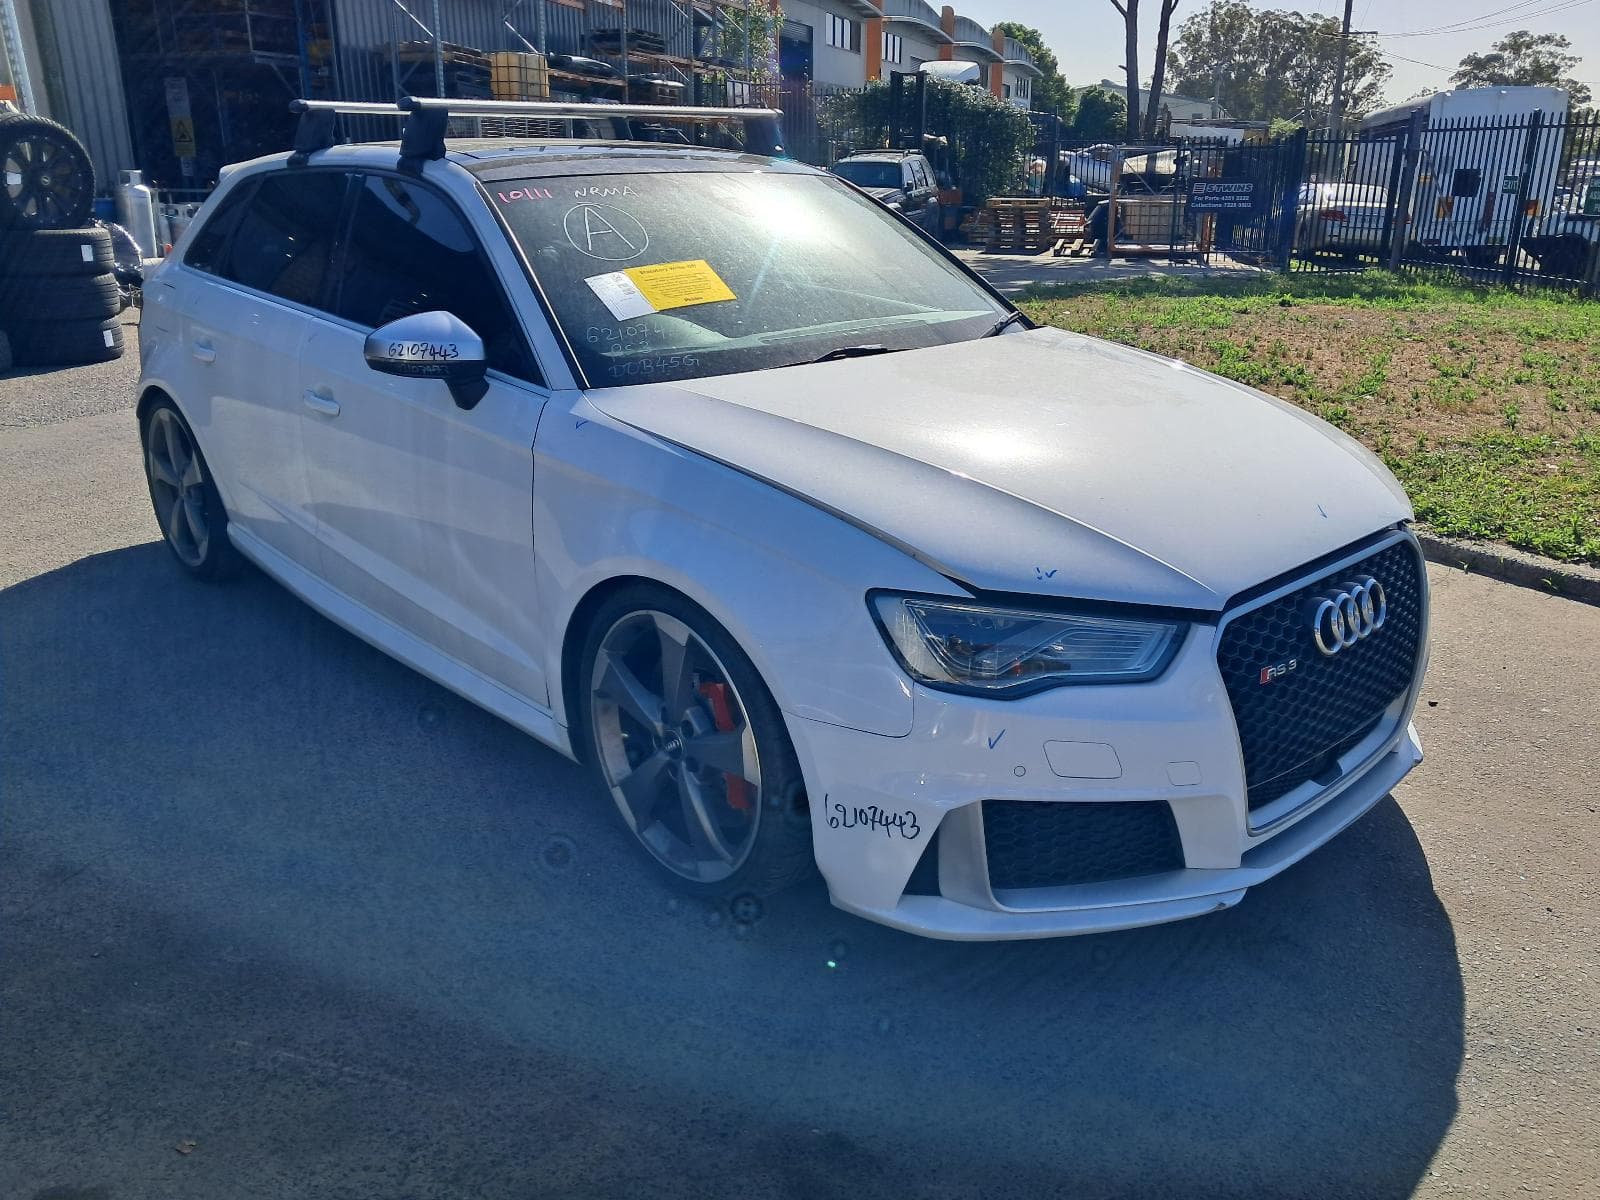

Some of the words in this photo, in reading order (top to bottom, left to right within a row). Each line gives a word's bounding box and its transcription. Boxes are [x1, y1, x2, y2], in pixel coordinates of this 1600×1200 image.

[574, 185, 640, 199] NRMA
[583, 205, 637, 252] A
[388, 342, 459, 361] 62107443
[824, 793, 921, 840] 62107443
